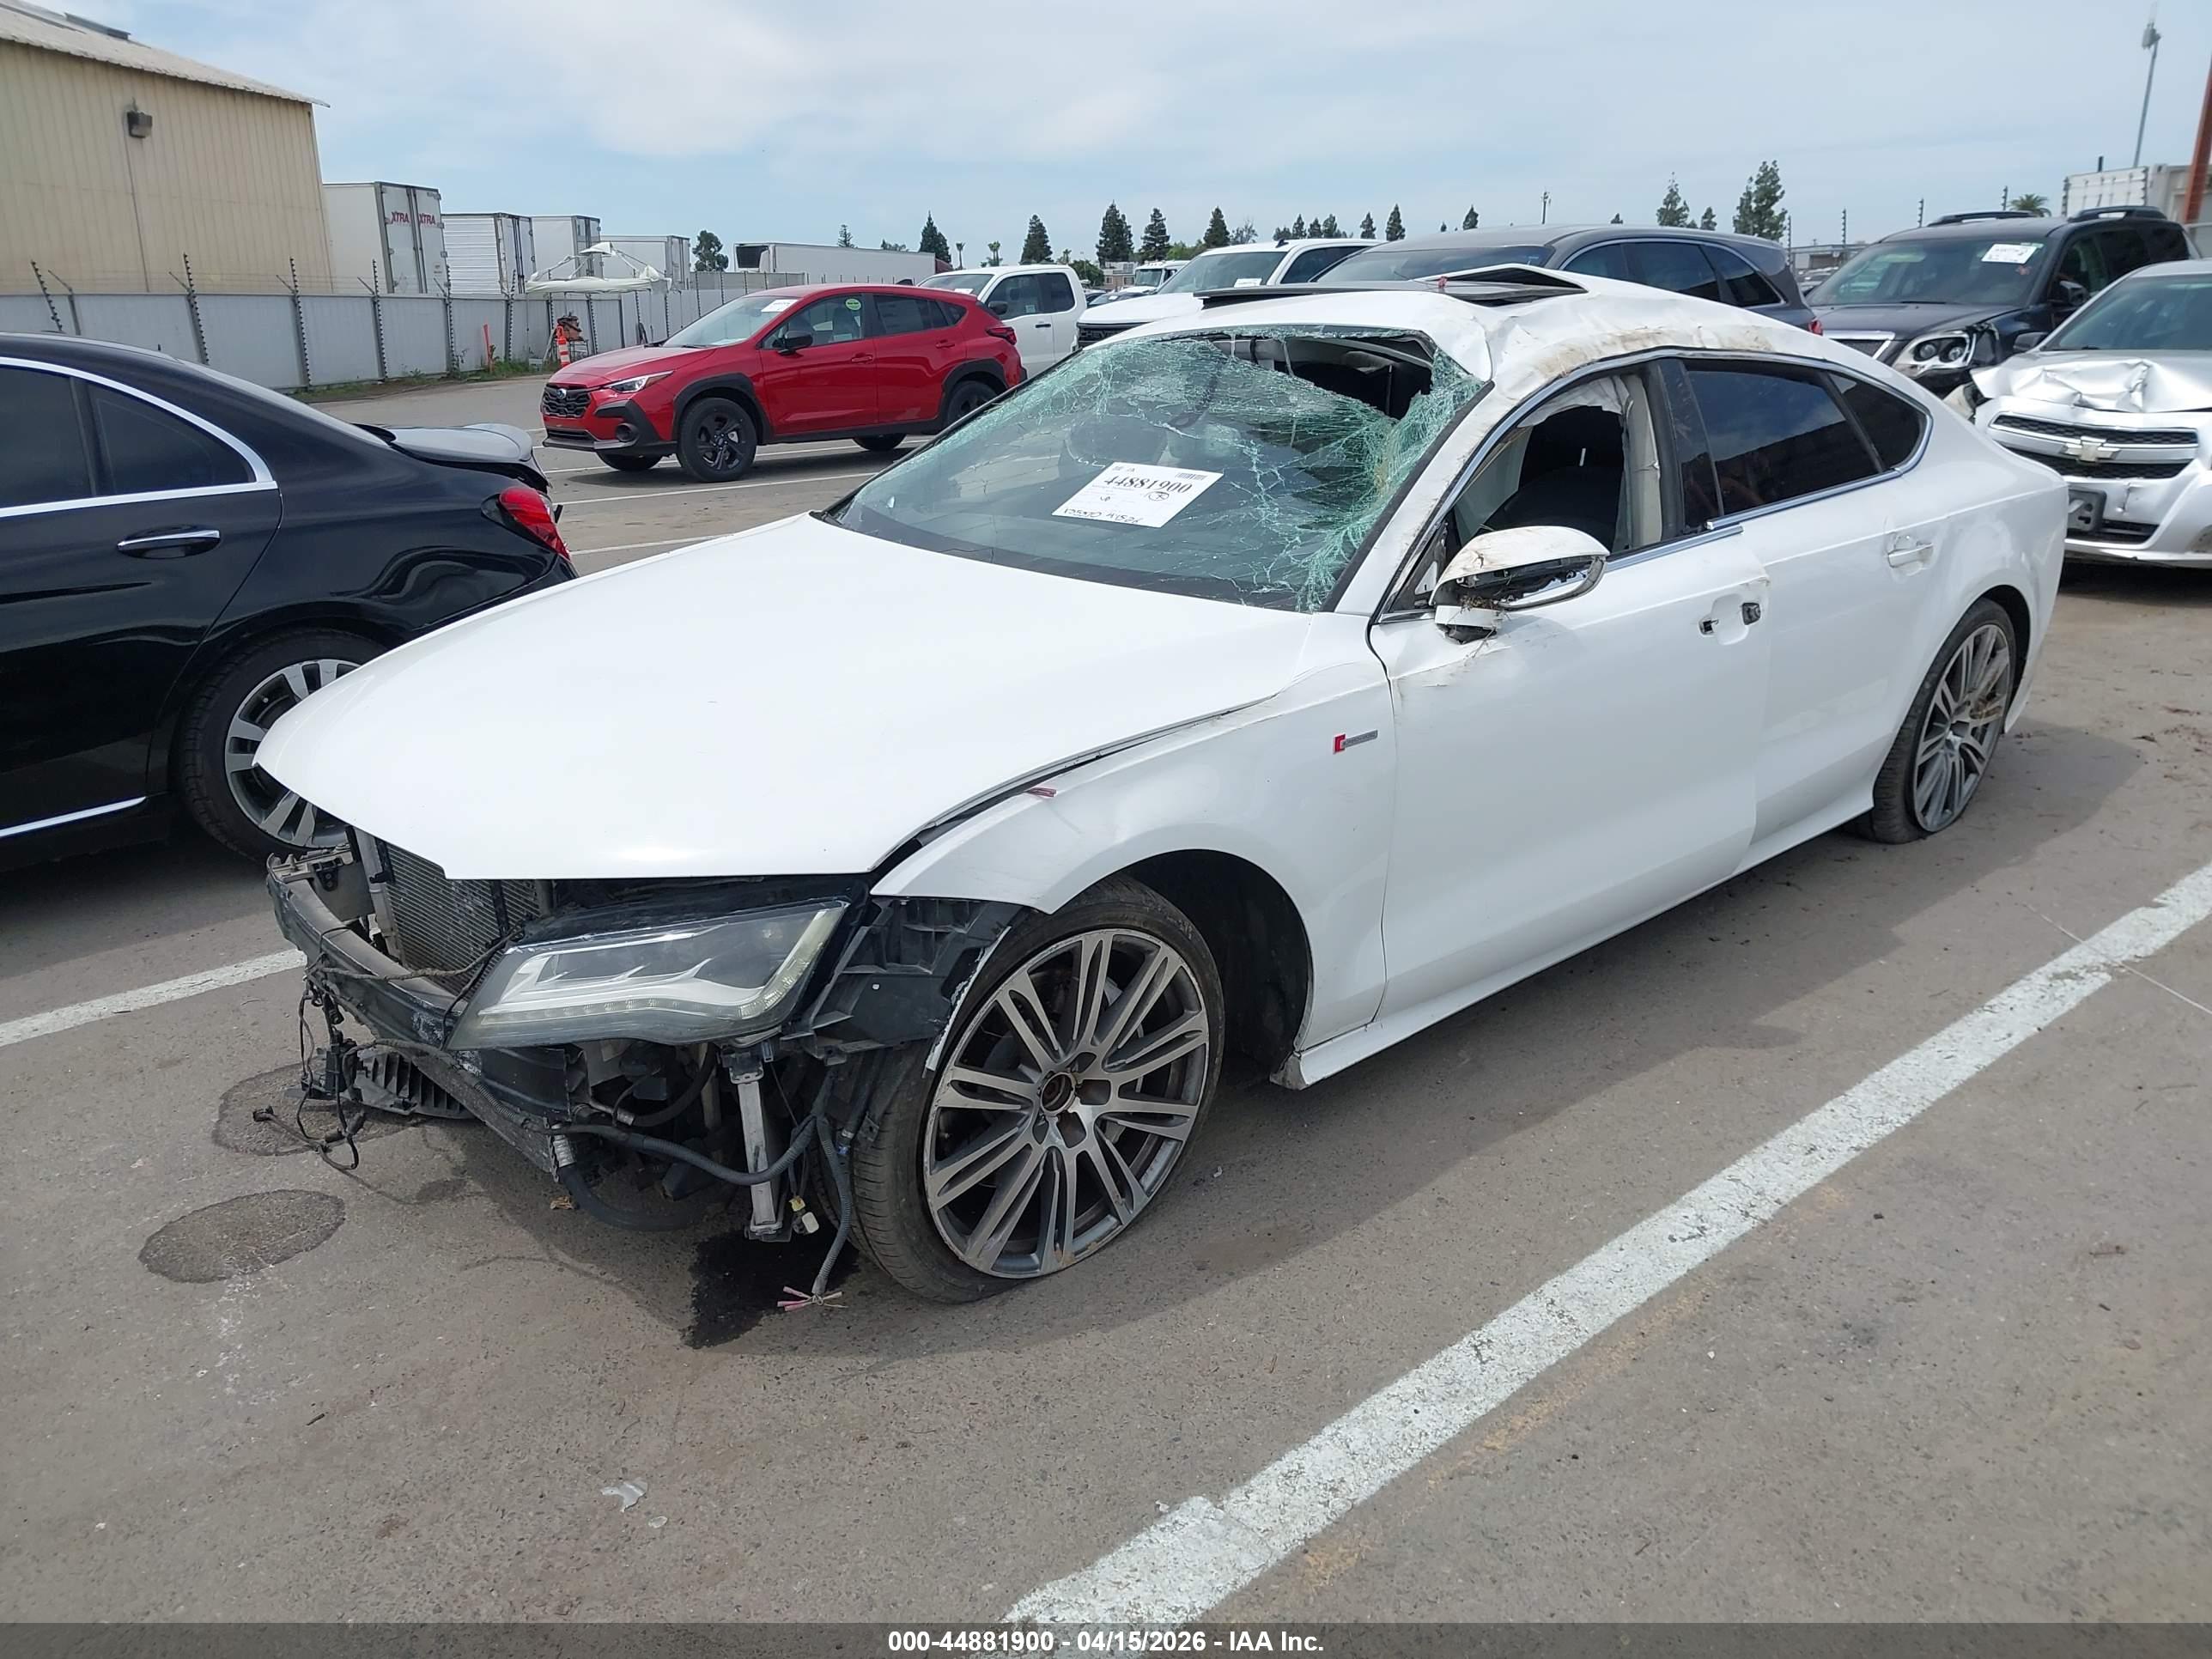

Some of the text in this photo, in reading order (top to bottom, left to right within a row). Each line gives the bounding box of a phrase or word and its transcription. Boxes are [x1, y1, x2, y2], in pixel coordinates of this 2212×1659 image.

[391, 210, 410, 224] XTRA
[418, 212, 436, 226] XTRA
[1104, 475, 1193, 494] 44881900
